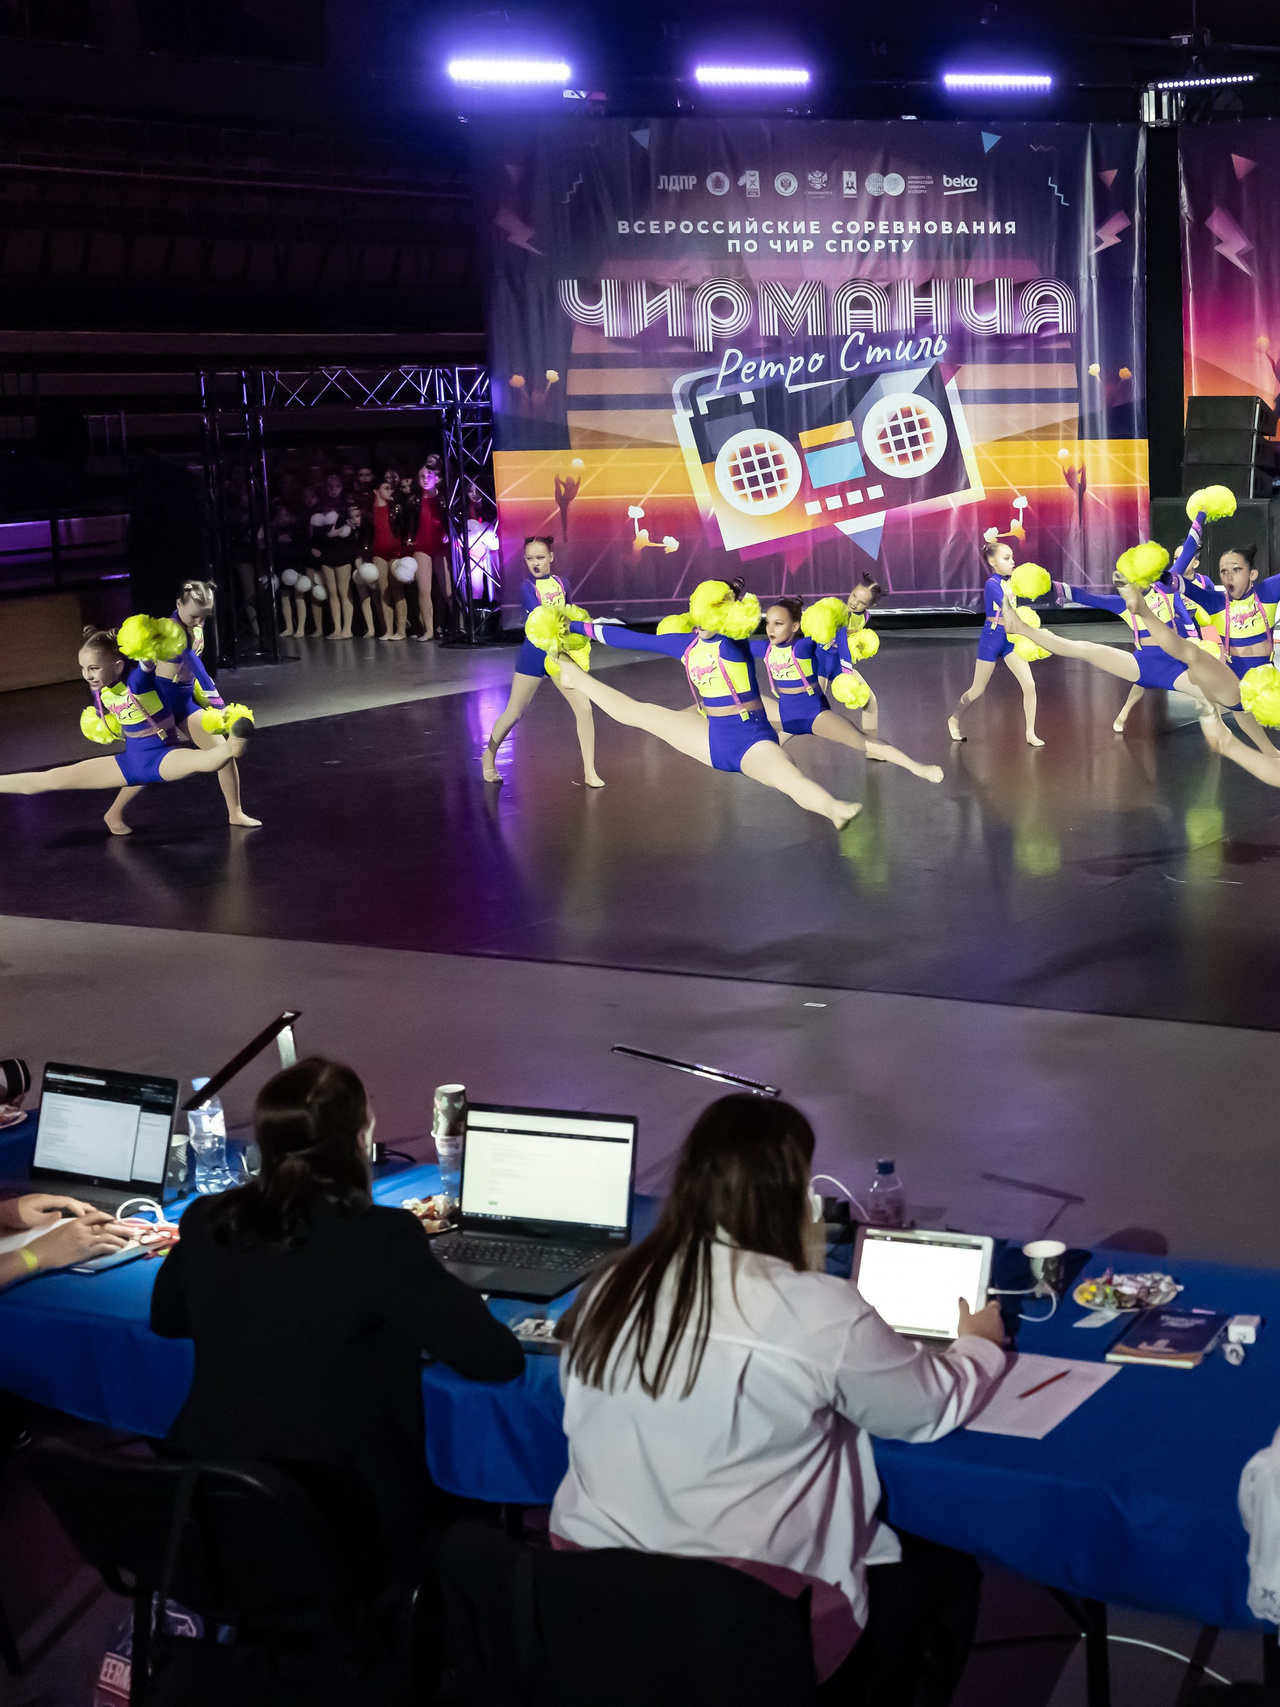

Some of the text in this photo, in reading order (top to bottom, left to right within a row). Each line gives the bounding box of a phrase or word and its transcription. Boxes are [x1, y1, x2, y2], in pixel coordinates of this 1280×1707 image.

[657, 174, 698, 192] ЛДПР
[942, 174, 979, 188] beko
[617, 217, 1017, 235] ВСЕРОССИЙСКИЕ СОРЕВНОВАНИЯ
[727, 239, 914, 253] ПО ЧИР СПОРТУ
[715, 331, 948, 390] Ретро Стиль
